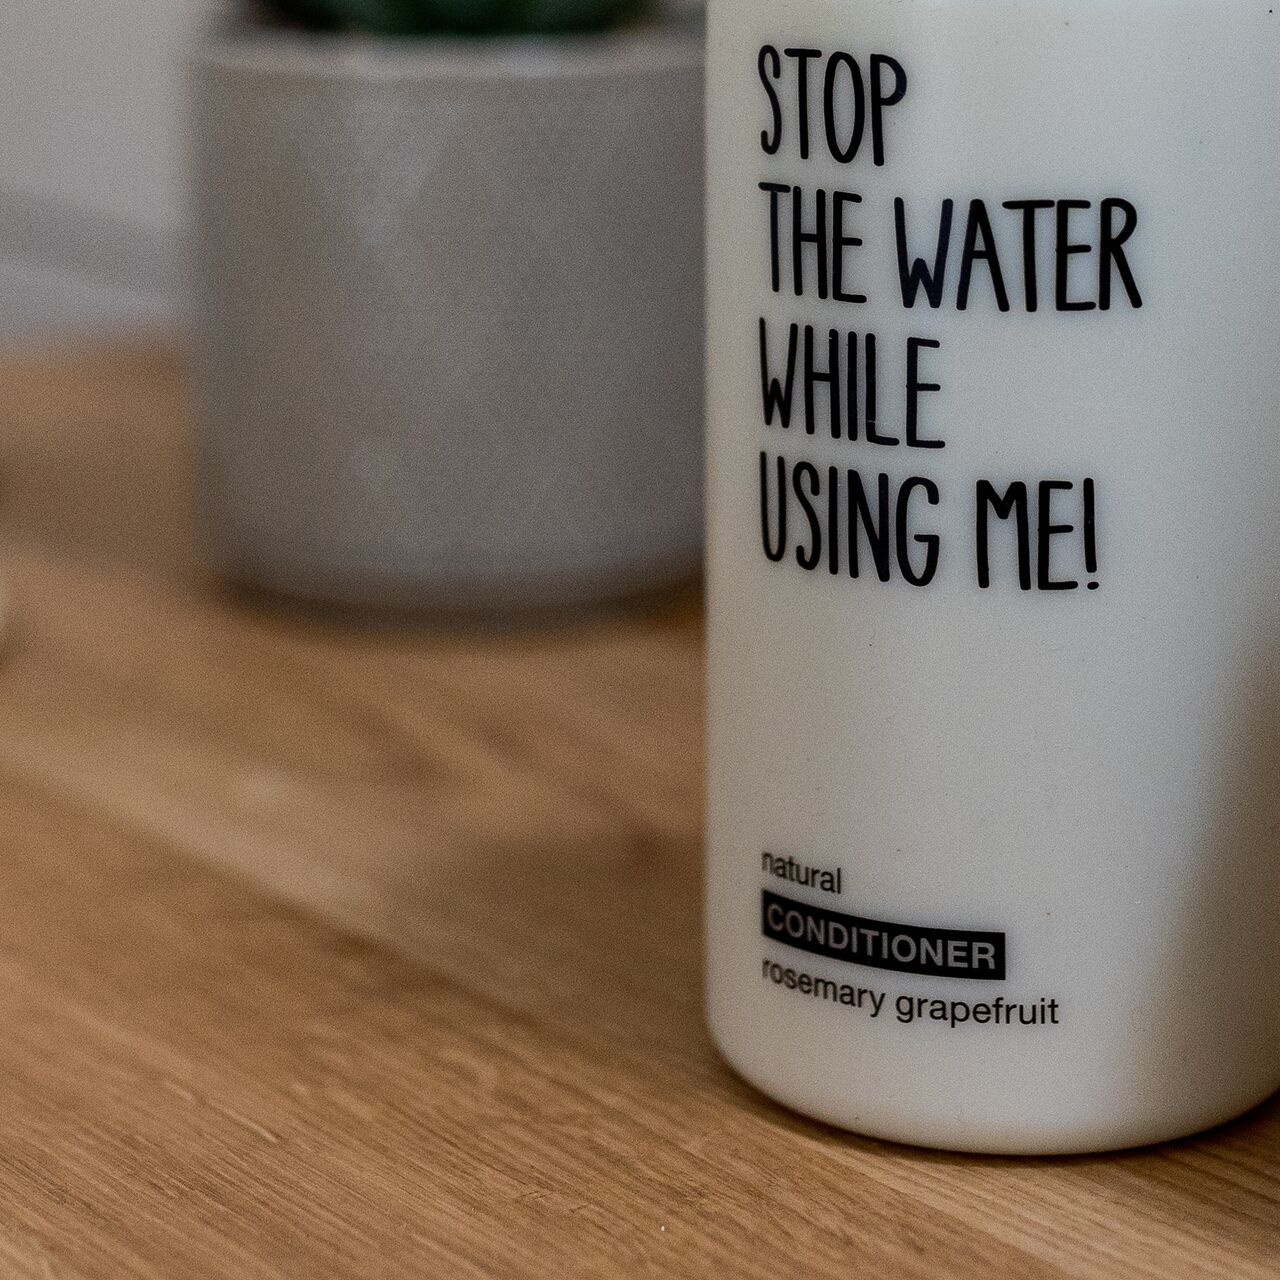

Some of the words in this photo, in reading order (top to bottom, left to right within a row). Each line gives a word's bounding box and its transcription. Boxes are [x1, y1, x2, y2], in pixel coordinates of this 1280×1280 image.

[757, 44, 908, 167] STOP
[758, 181, 867, 304] THE
[894, 197, 1143, 313] WATER
[758, 317, 946, 448] WHILE
[759, 451, 940, 587] USING
[975, 477, 1100, 591] ME!
[762, 851, 842, 894] natural
[762, 956, 886, 1018] rosemary
[896, 997, 1060, 1028] grapefruit
[767, 903, 996, 970] CONDITIONER
